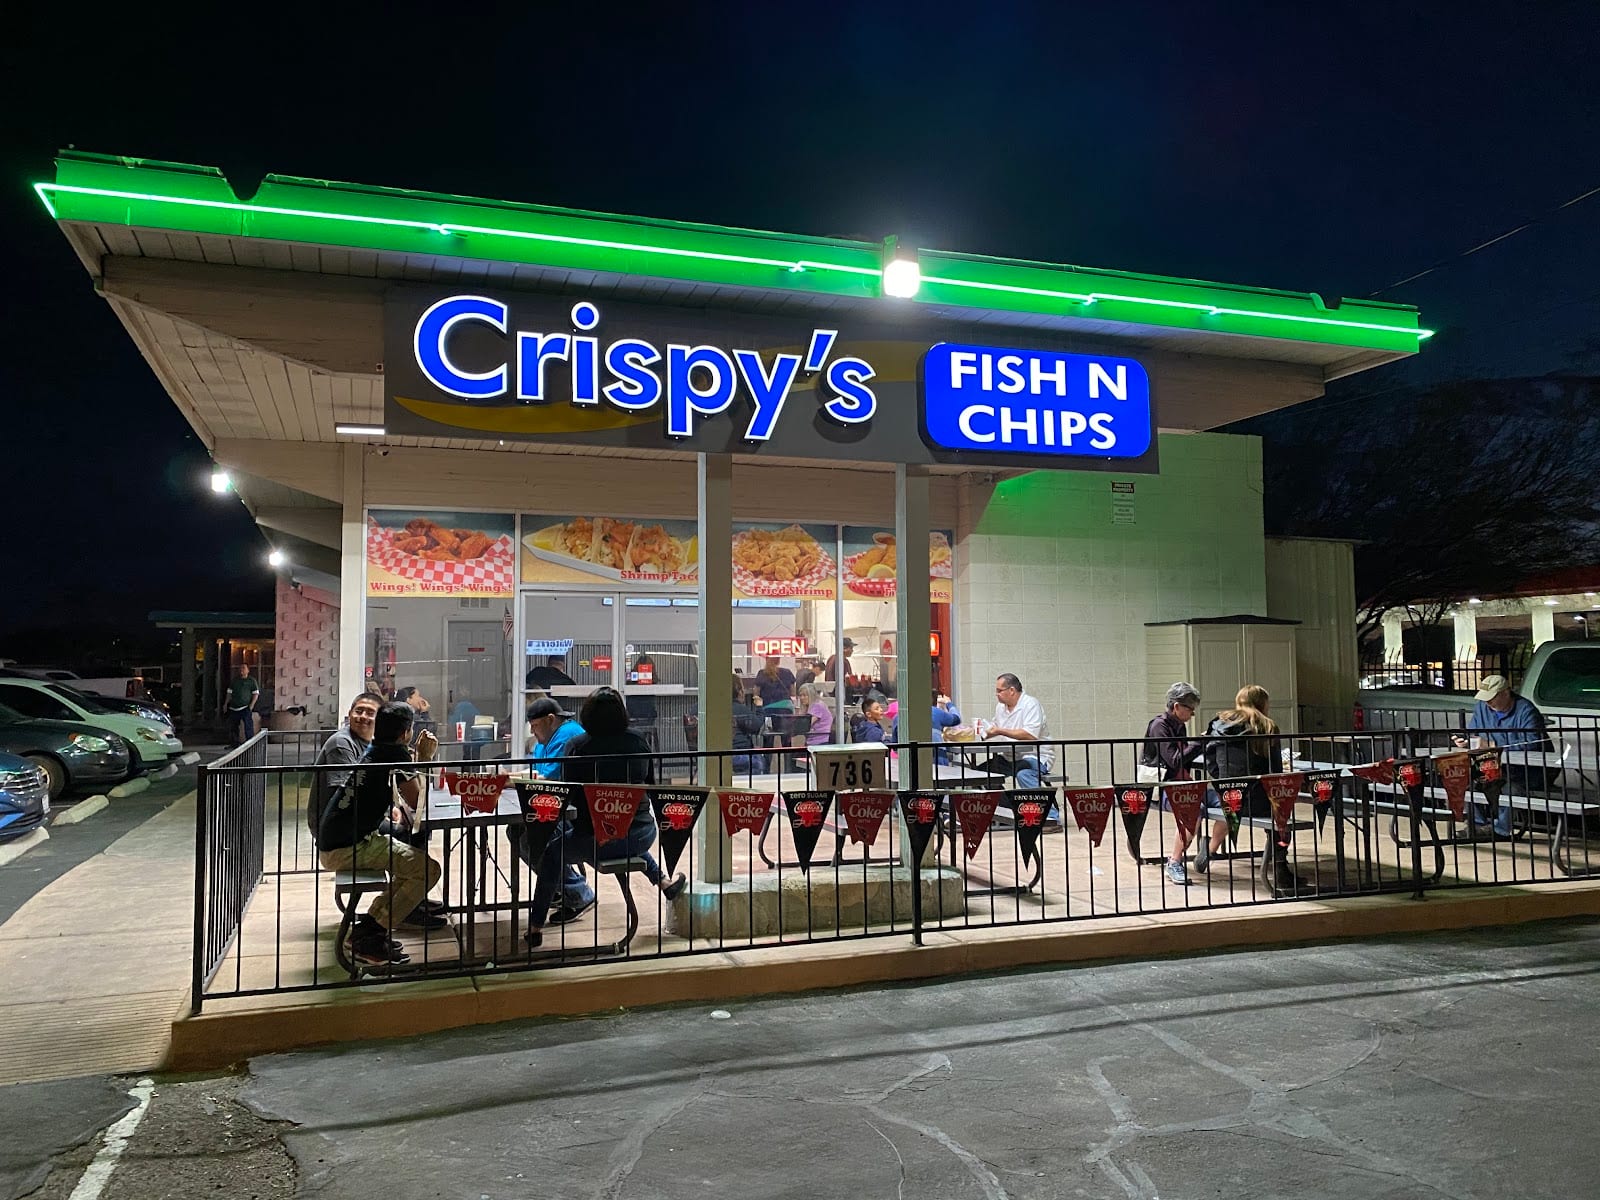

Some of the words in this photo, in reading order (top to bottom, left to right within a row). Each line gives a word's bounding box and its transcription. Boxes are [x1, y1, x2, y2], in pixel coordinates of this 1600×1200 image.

[414, 295, 876, 440] Crispy's
[951, 351, 1067, 397] FISH
[1088, 362, 1128, 401] N
[958, 404, 1117, 450] CHIPS
[620, 570, 669, 583] Shrimp
[671, 570, 698, 580] Tac
[370, 581, 415, 593] Wings!
[420, 582, 464, 594] Wings!
[468, 583, 512, 594] Wings!
[754, 586, 788, 596] Fried
[789, 587, 833, 598] Shrimp
[754, 639, 806, 655] OPEN
[829, 760, 872, 786] 736
[1444, 765, 1466, 779] Coke
[455, 780, 497, 796] Coke
[596, 790, 625, 798] SHARE
[1270, 786, 1294, 798] Coke
[728, 795, 756, 803] SHARE
[1075, 792, 1099, 800] SHARE
[1172, 791, 1199, 804] Coke
[594, 798, 633, 814] Coke
[728, 802, 764, 818] Coke
[849, 803, 882, 819] Coke
[960, 800, 991, 814] Coke
[1076, 800, 1107, 814] Coke
